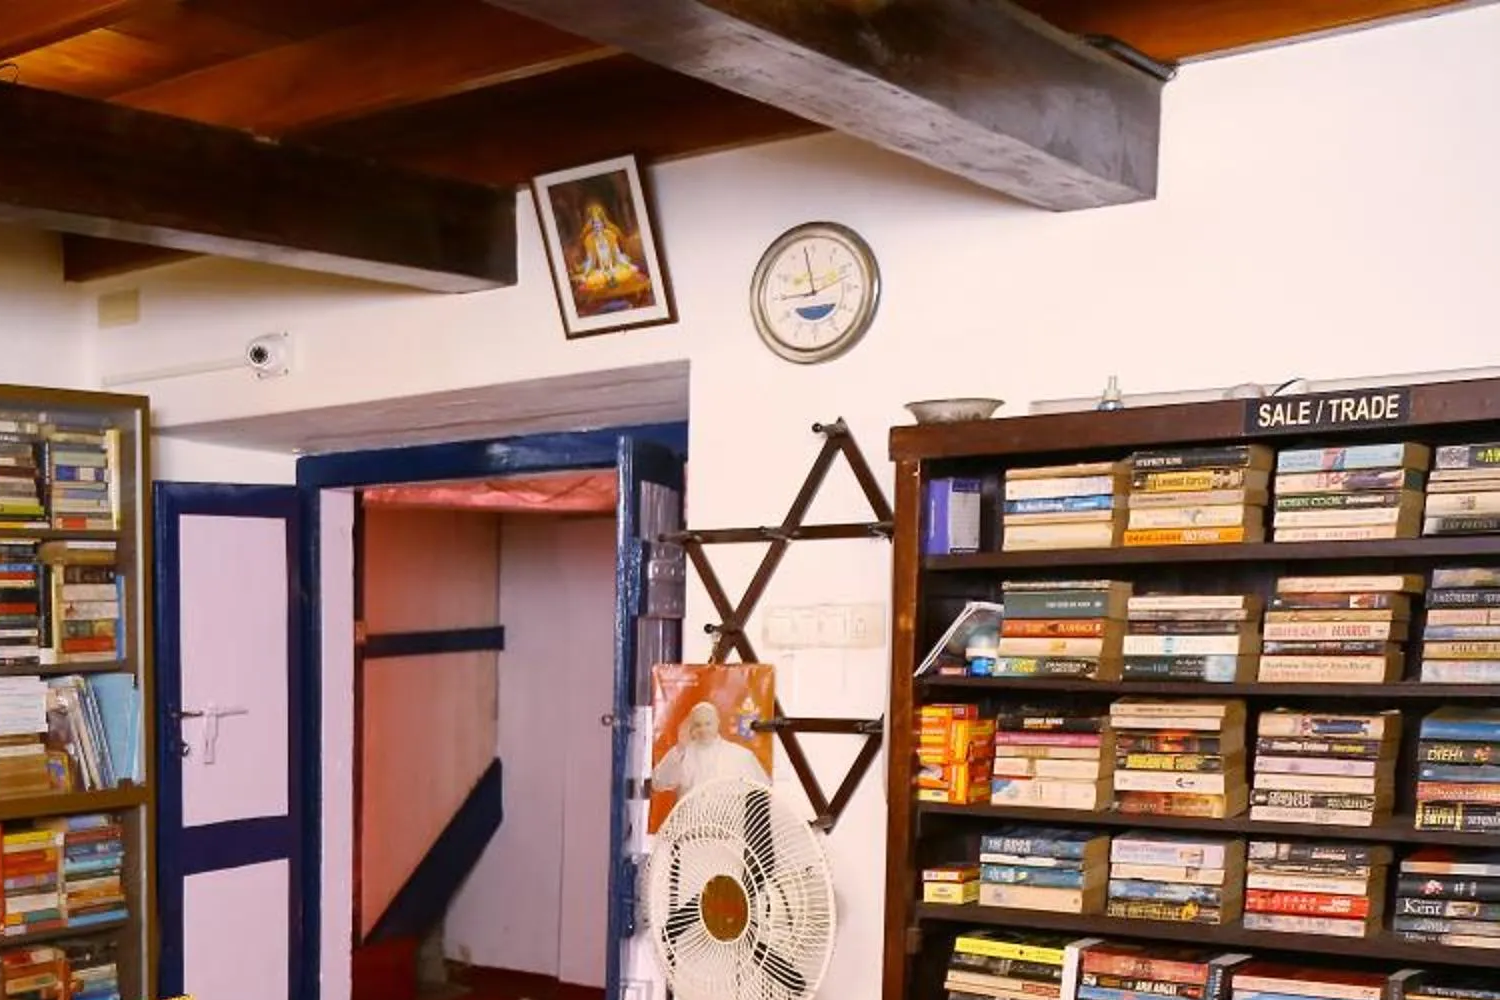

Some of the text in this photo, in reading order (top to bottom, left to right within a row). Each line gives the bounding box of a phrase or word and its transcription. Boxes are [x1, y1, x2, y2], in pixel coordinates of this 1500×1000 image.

[1258, 401, 1311, 427] SALE
[1329, 394, 1400, 423] TRADE
[1312, 495, 1343, 506] COOK
[1404, 898, 1442, 915] Kent
